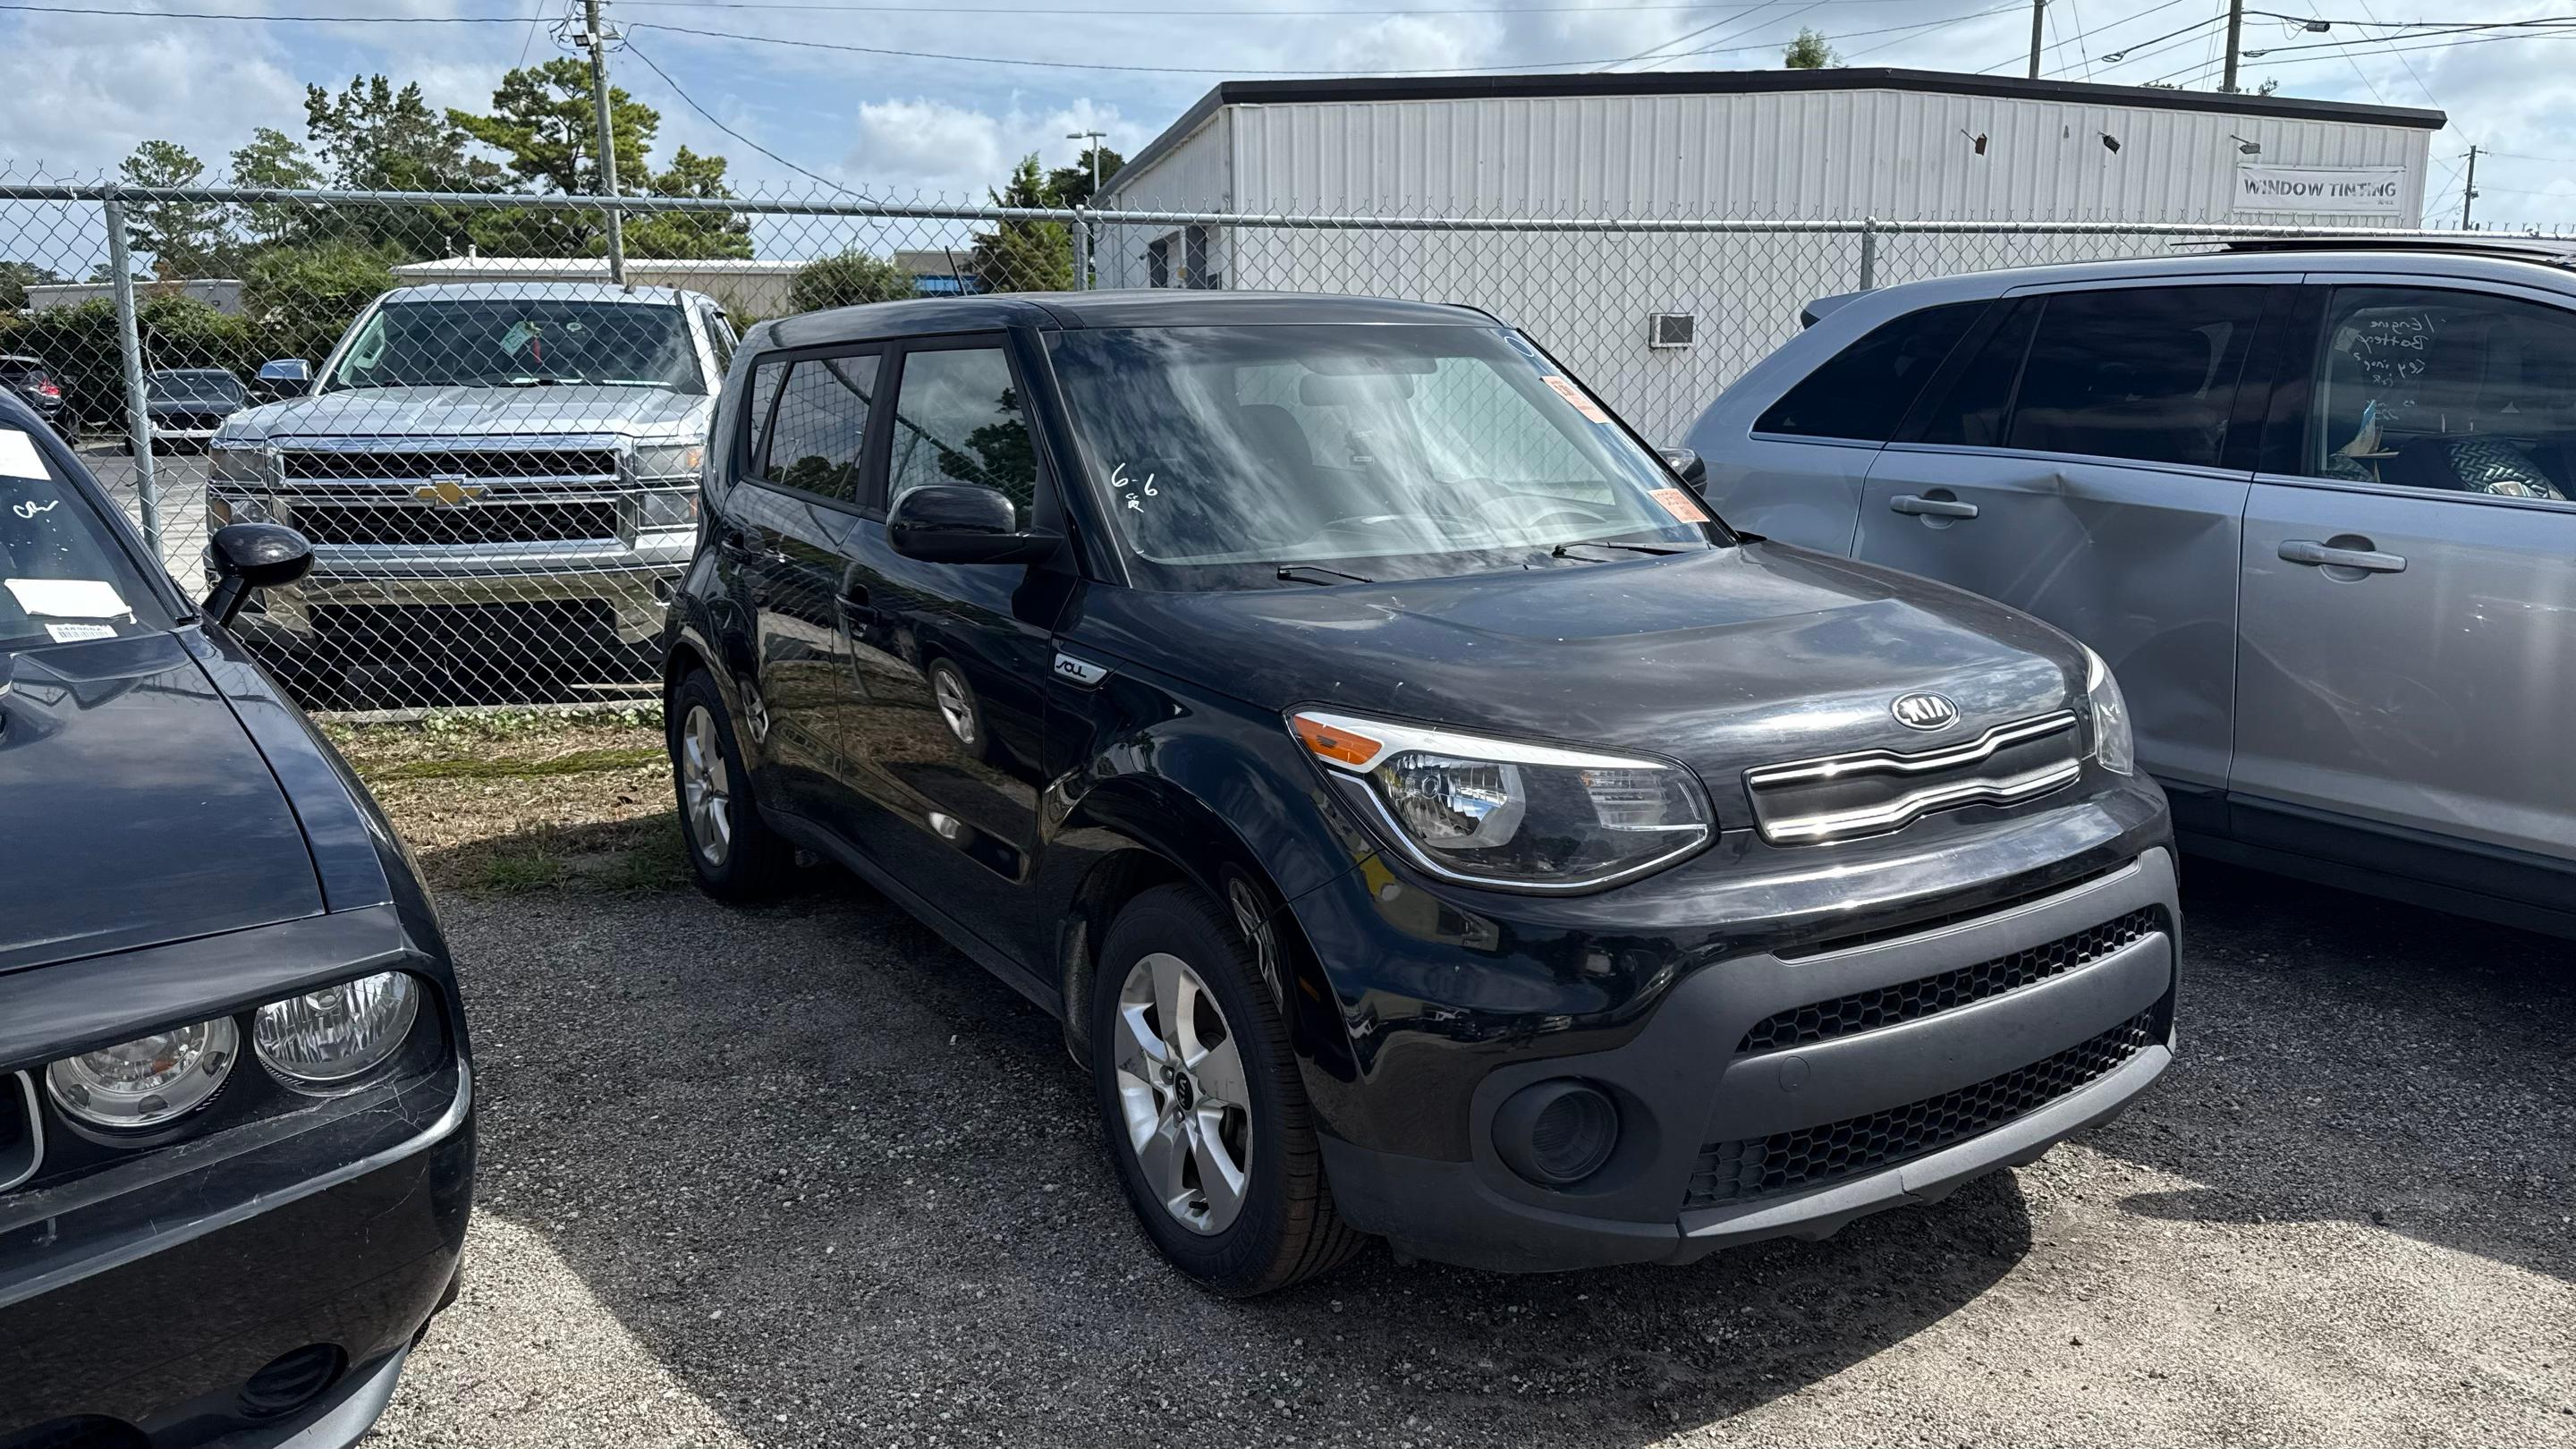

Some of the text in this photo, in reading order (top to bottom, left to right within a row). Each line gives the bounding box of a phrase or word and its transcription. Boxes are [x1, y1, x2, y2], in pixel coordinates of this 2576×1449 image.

[2243, 178, 2396, 198] WINDOW TINTING
[1900, 696, 1953, 722] KIA
